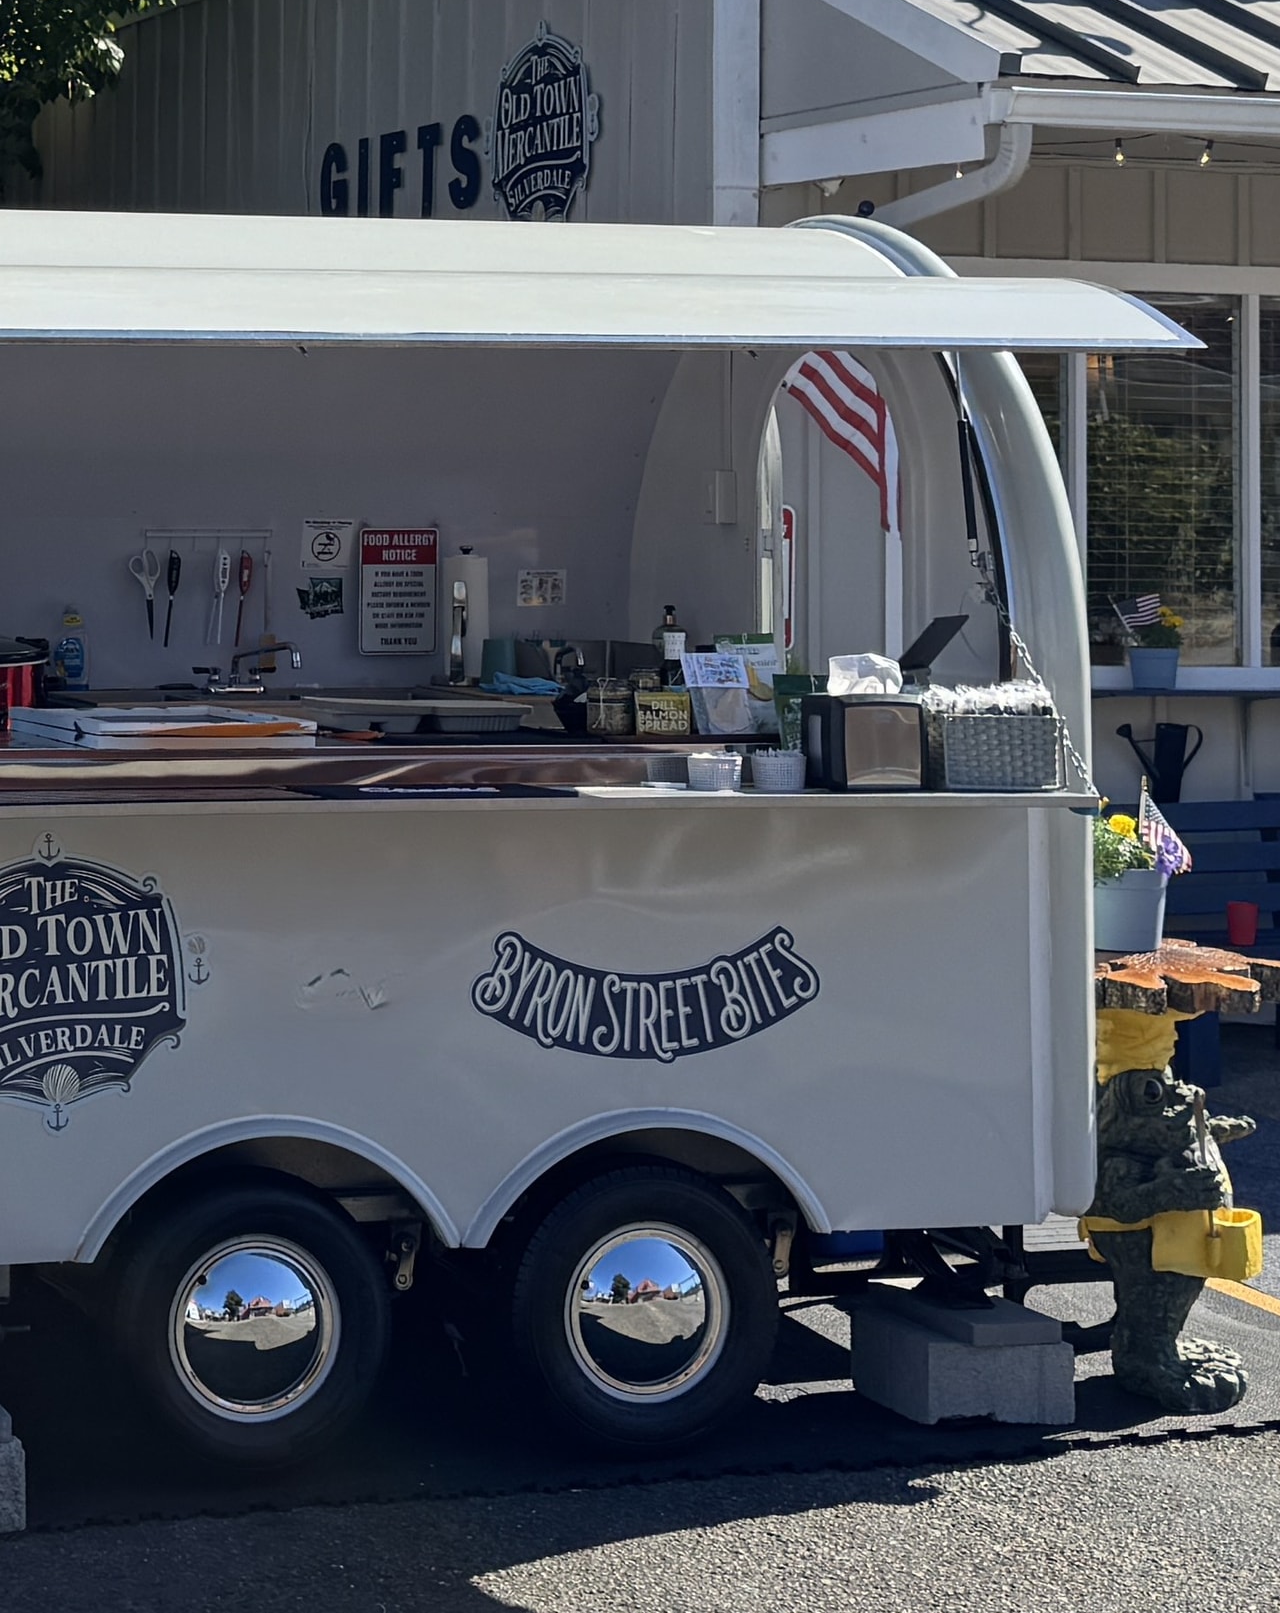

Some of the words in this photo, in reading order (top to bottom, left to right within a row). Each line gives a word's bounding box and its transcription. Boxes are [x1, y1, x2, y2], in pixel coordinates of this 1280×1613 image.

[529, 55, 550, 85] THE
[501, 87, 531, 129] OLD
[534, 75, 581, 117] TOWN
[320, 114, 482, 218] GIFTS
[495, 112, 583, 183] MERCANTILE
[508, 169, 573, 211] SILVERDALE
[363, 534, 390, 546] FOOD
[392, 534, 435, 546] ALLERGY
[382, 550, 417, 561] NOTICE
[639, 710, 687, 720] SALMON
[651, 700, 677, 710] DILL
[639, 720, 688, 732] SPREAD
[24, 876, 79, 916] THE
[36, 908, 163, 957] TOWN
[475, 935, 597, 1048] BYRON
[592, 972, 715, 1061] STREET
[710, 931, 818, 1039] BITES
